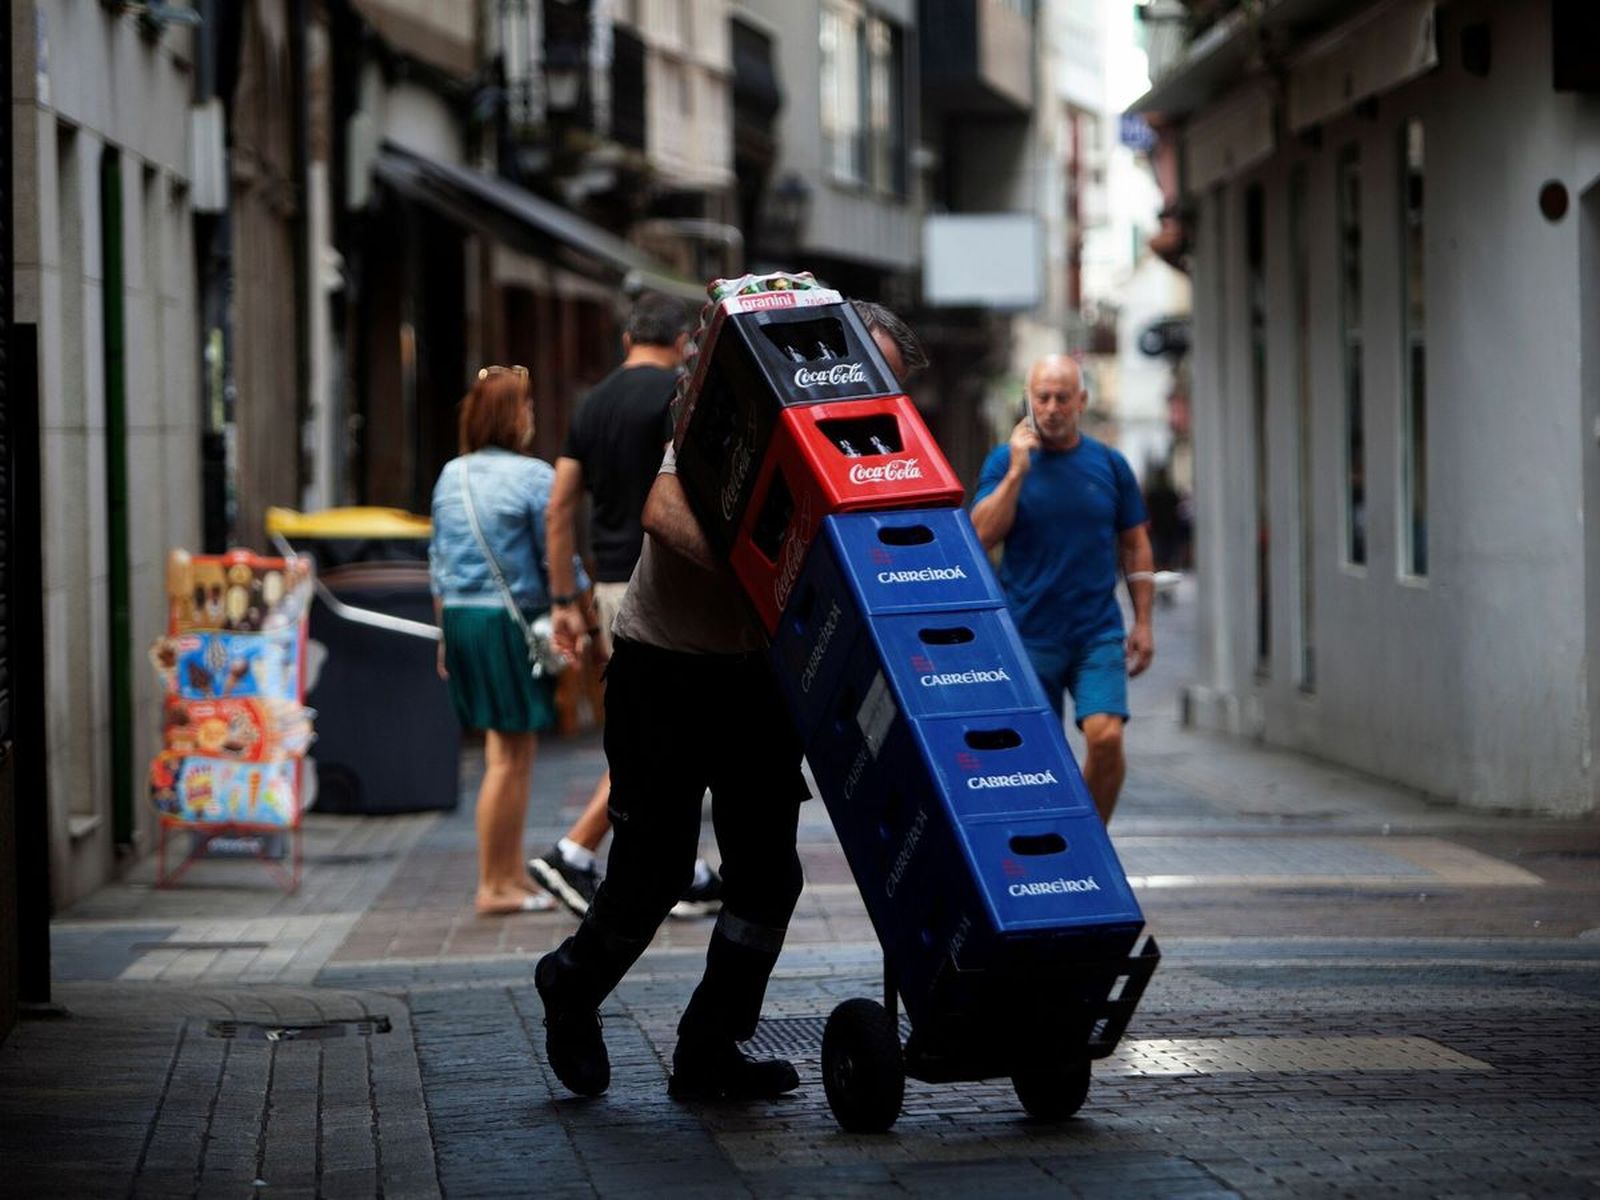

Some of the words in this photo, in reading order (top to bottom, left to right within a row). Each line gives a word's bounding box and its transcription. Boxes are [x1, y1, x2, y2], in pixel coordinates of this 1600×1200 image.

[742, 293, 793, 309] granini
[794, 361, 865, 388] Coca-Cola
[849, 458, 921, 485] Coca-Cola
